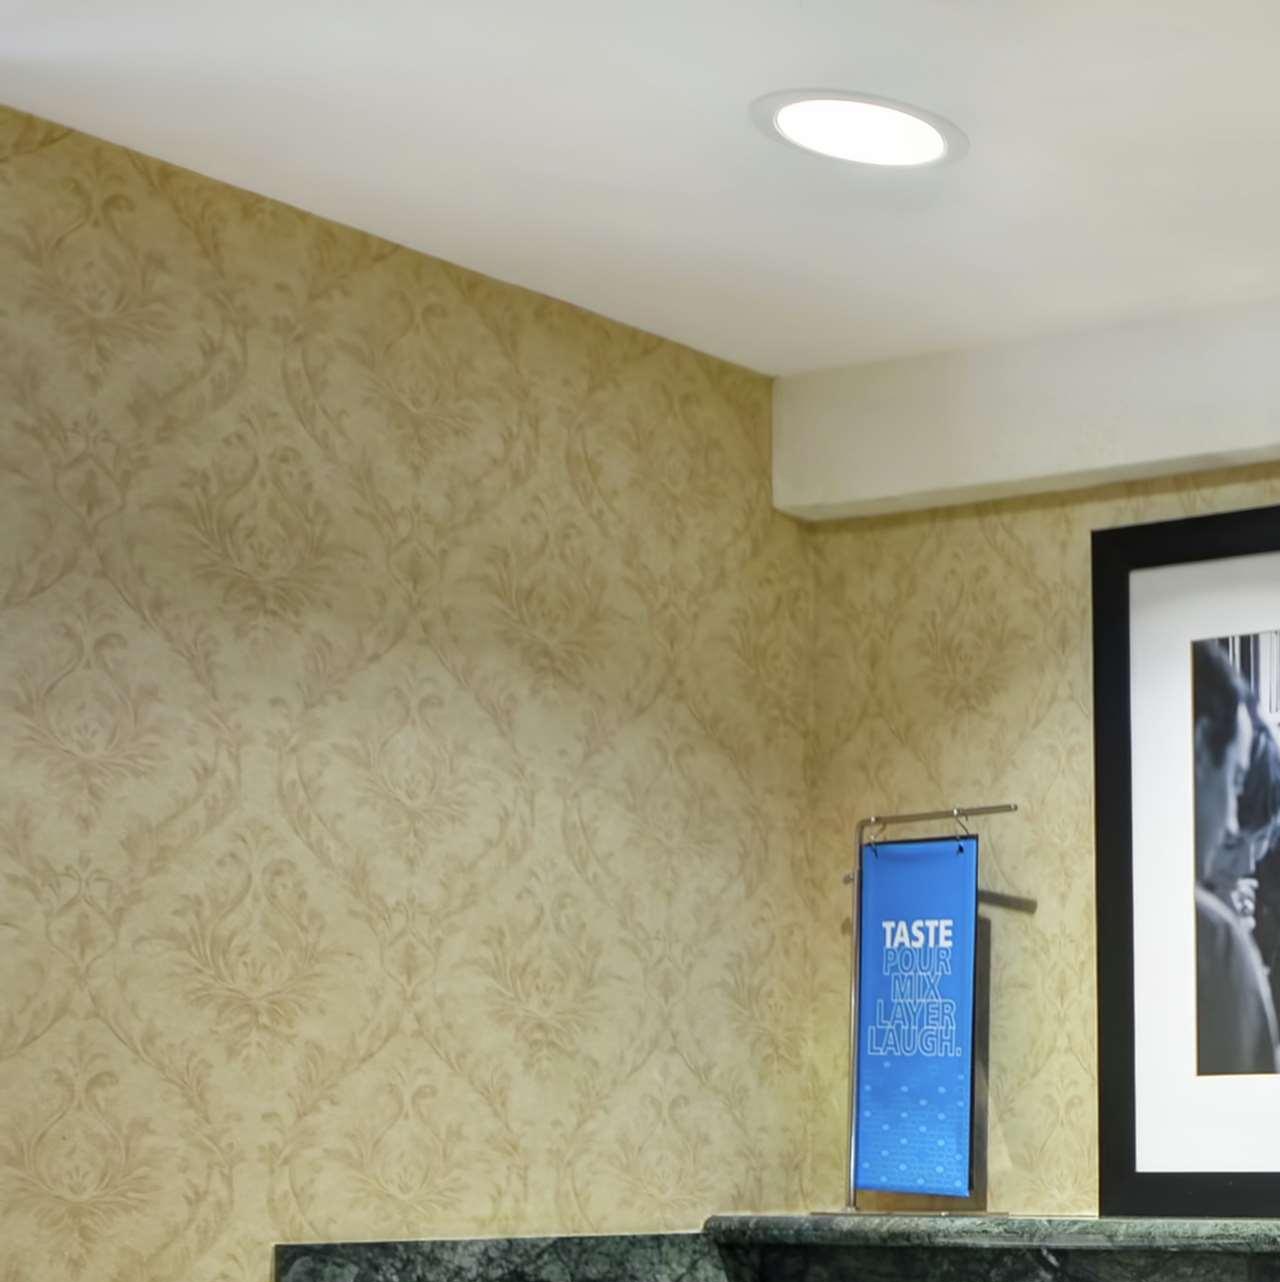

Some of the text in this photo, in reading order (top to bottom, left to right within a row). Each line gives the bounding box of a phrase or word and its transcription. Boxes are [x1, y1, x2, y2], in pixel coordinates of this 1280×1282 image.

[882, 919, 953, 948] TASTE
[883, 947, 952, 975] POUR
[892, 973, 942, 1001] MIX
[876, 999, 956, 1029] LAYER
[868, 1026, 962, 1056] LAUGH.
